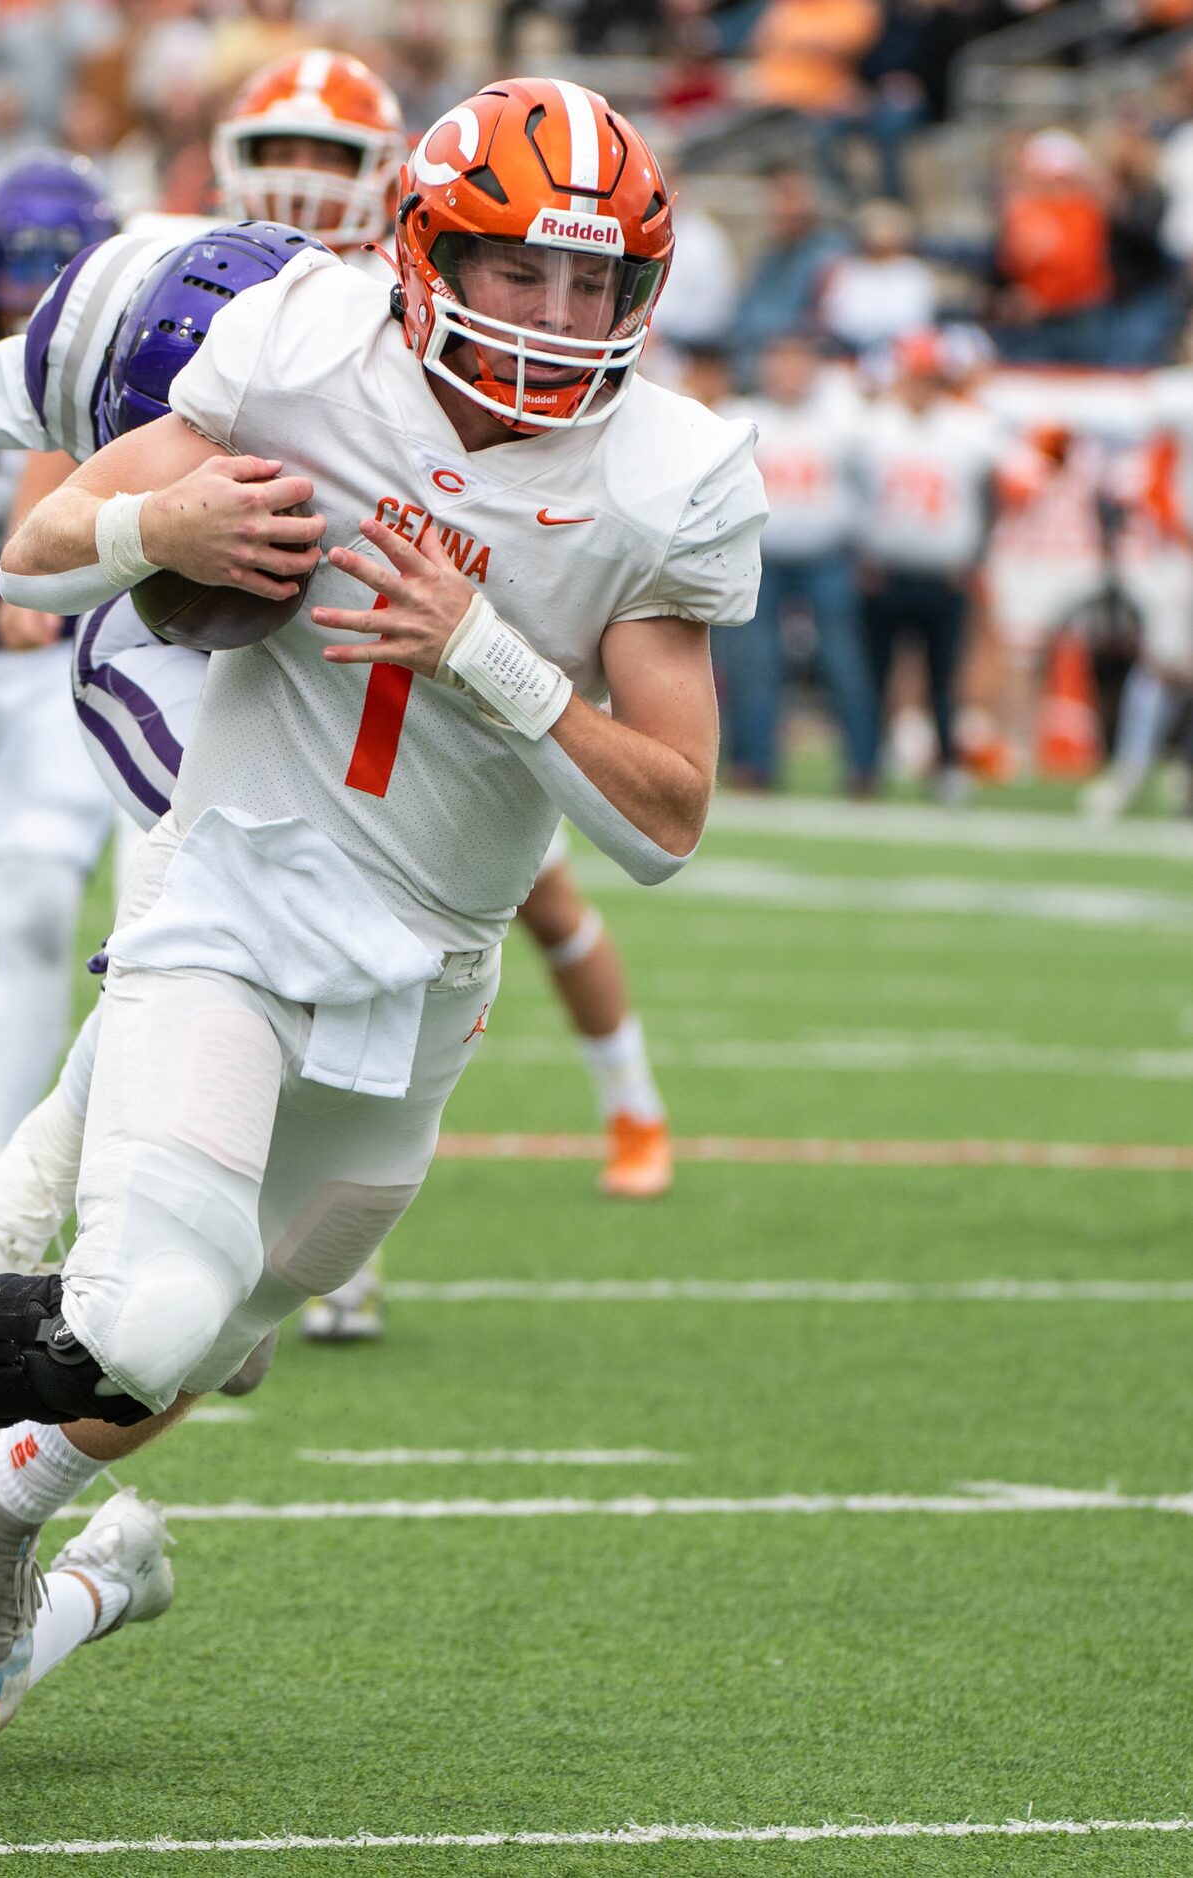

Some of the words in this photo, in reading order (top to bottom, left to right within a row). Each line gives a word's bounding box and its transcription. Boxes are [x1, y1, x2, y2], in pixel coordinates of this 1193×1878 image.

[411, 107, 479, 186] C
[541, 217, 618, 245] Riddell
[523, 394, 558, 404] Riddell
[431, 468, 467, 495] C
[374, 496, 491, 584] CELINA
